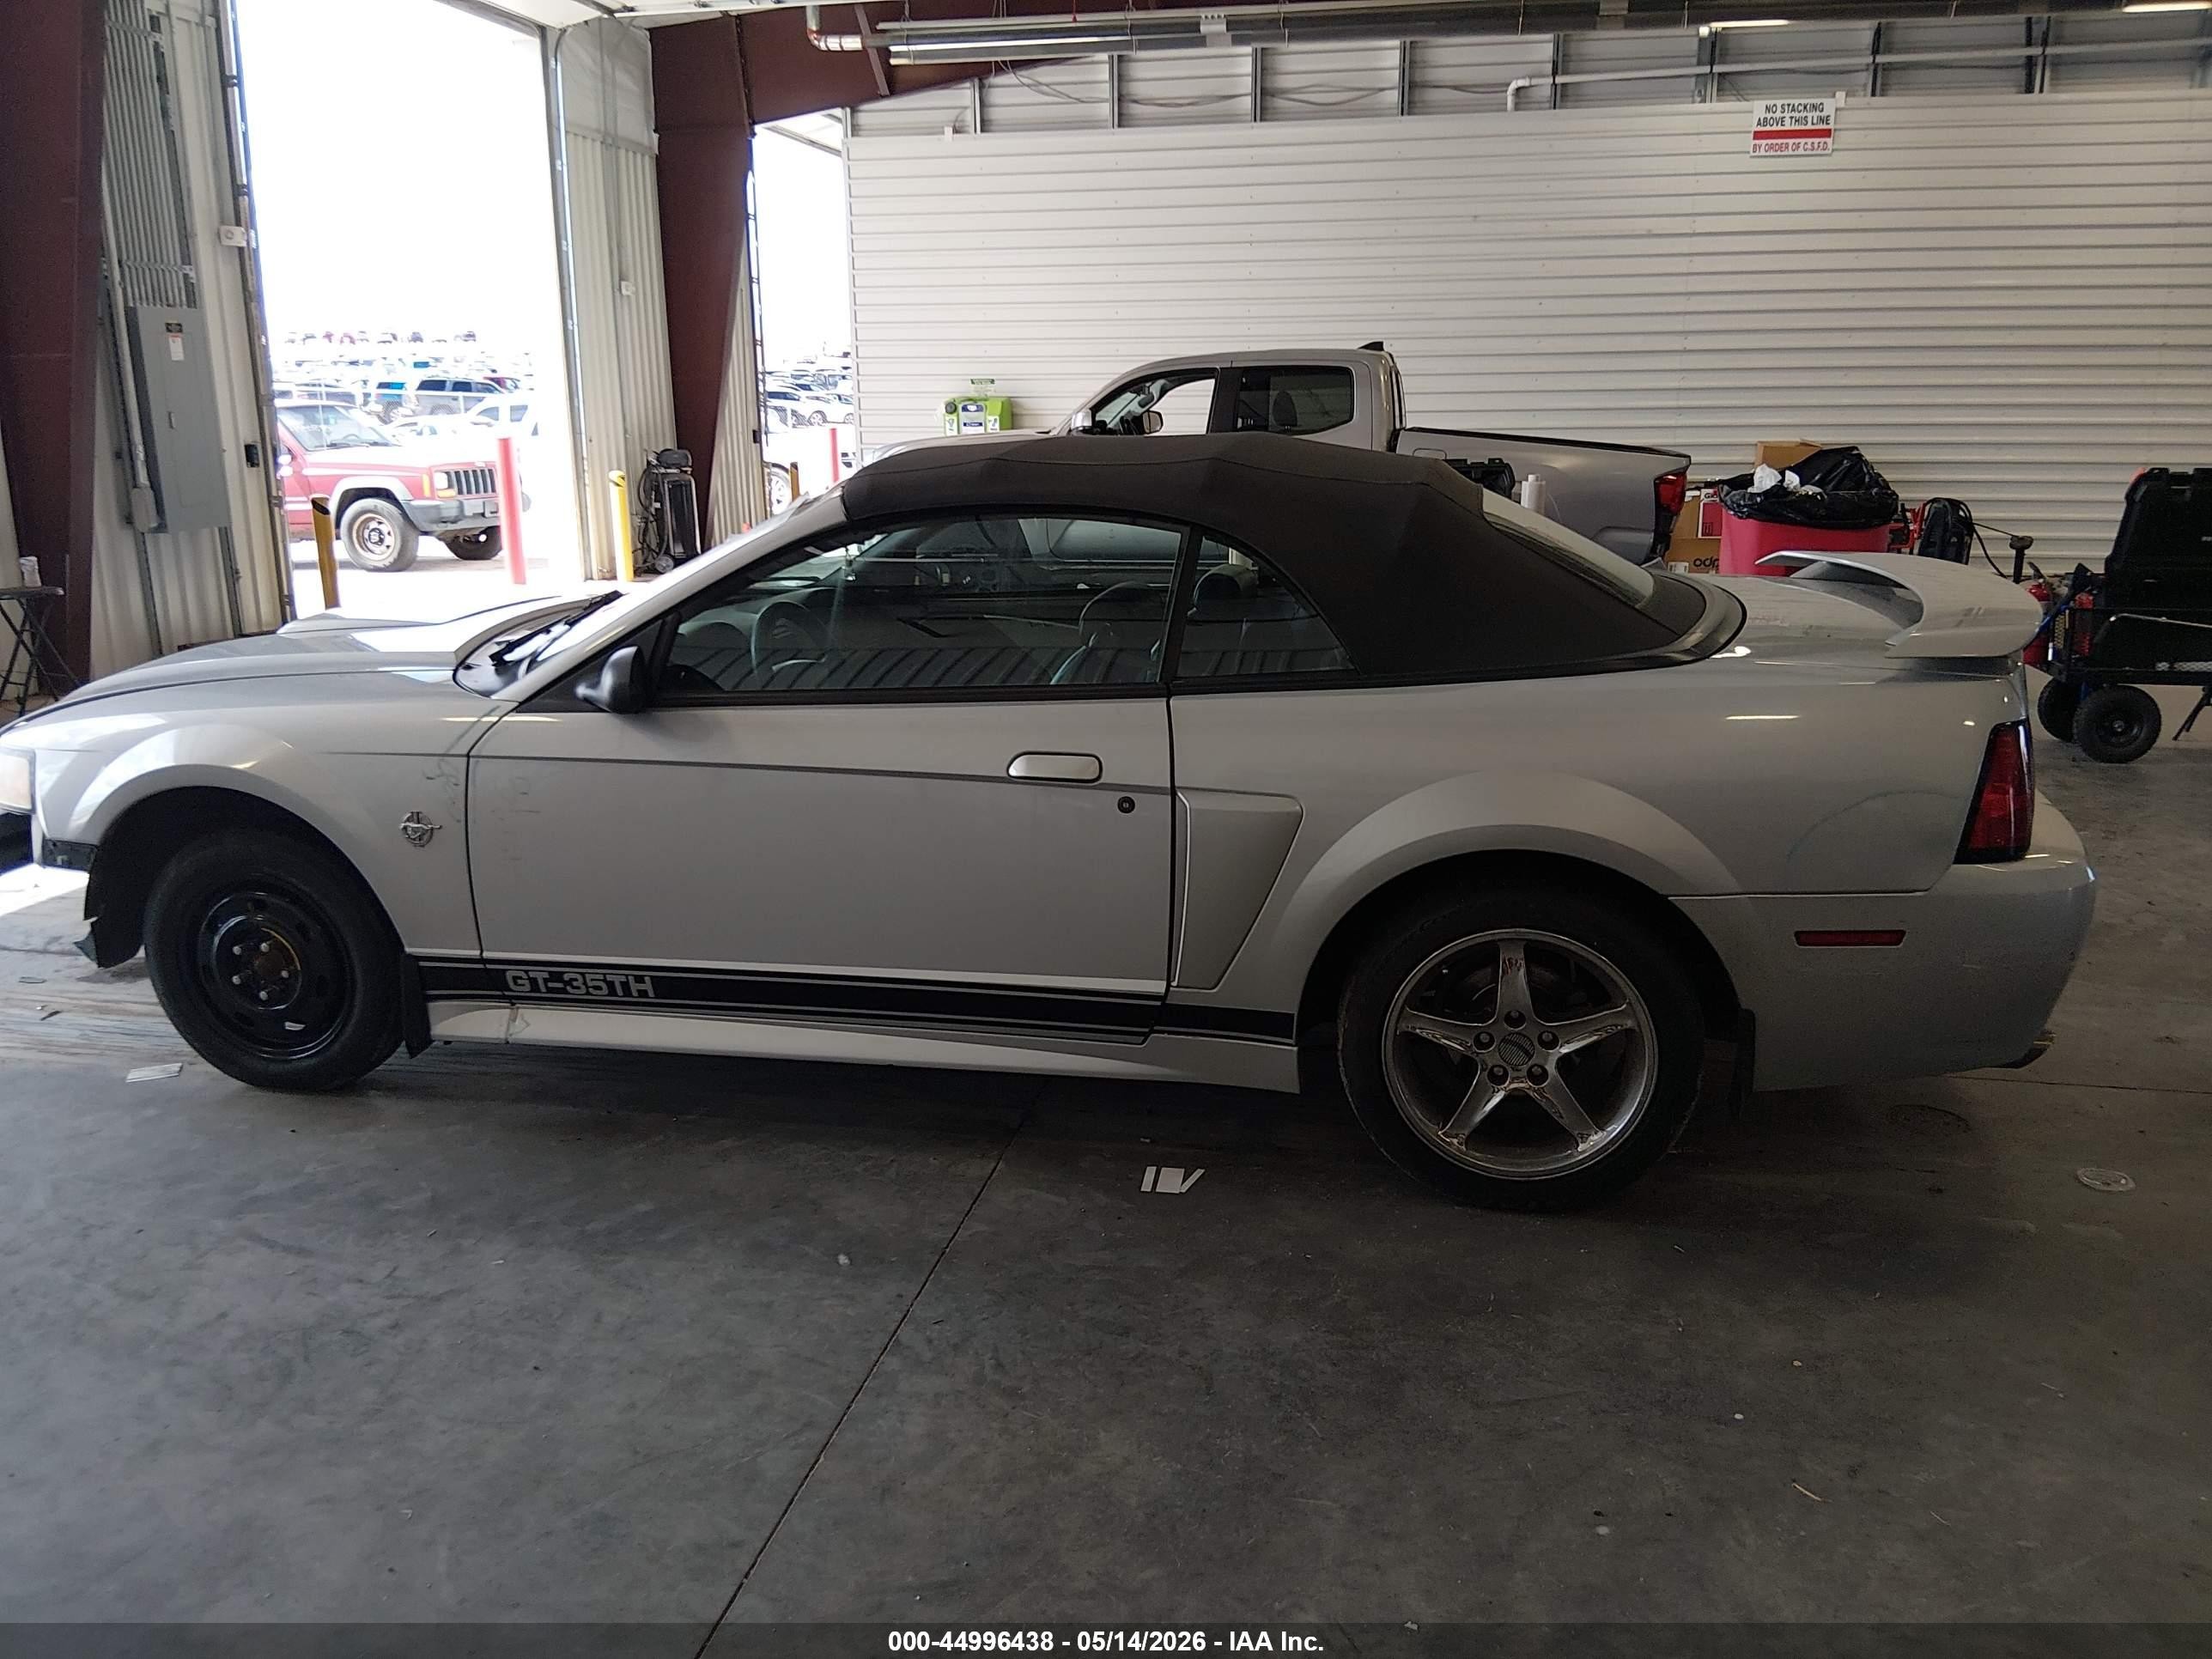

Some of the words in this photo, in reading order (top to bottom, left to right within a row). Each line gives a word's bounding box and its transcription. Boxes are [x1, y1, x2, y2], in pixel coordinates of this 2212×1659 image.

[1765, 103, 1778, 114] NO
[1780, 102, 1824, 114] STACKING
[1756, 116, 1785, 127] ABOVE
[1789, 115, 1808, 126] THIS
[1811, 114, 1831, 125] LINE
[1752, 143, 1762, 153] BY
[1764, 142, 1789, 153] ORDER
[1791, 142, 1802, 152] OF
[1802, 141, 1830, 152] C.S.F.D.
[506, 969, 655, 998] GT-35TH
